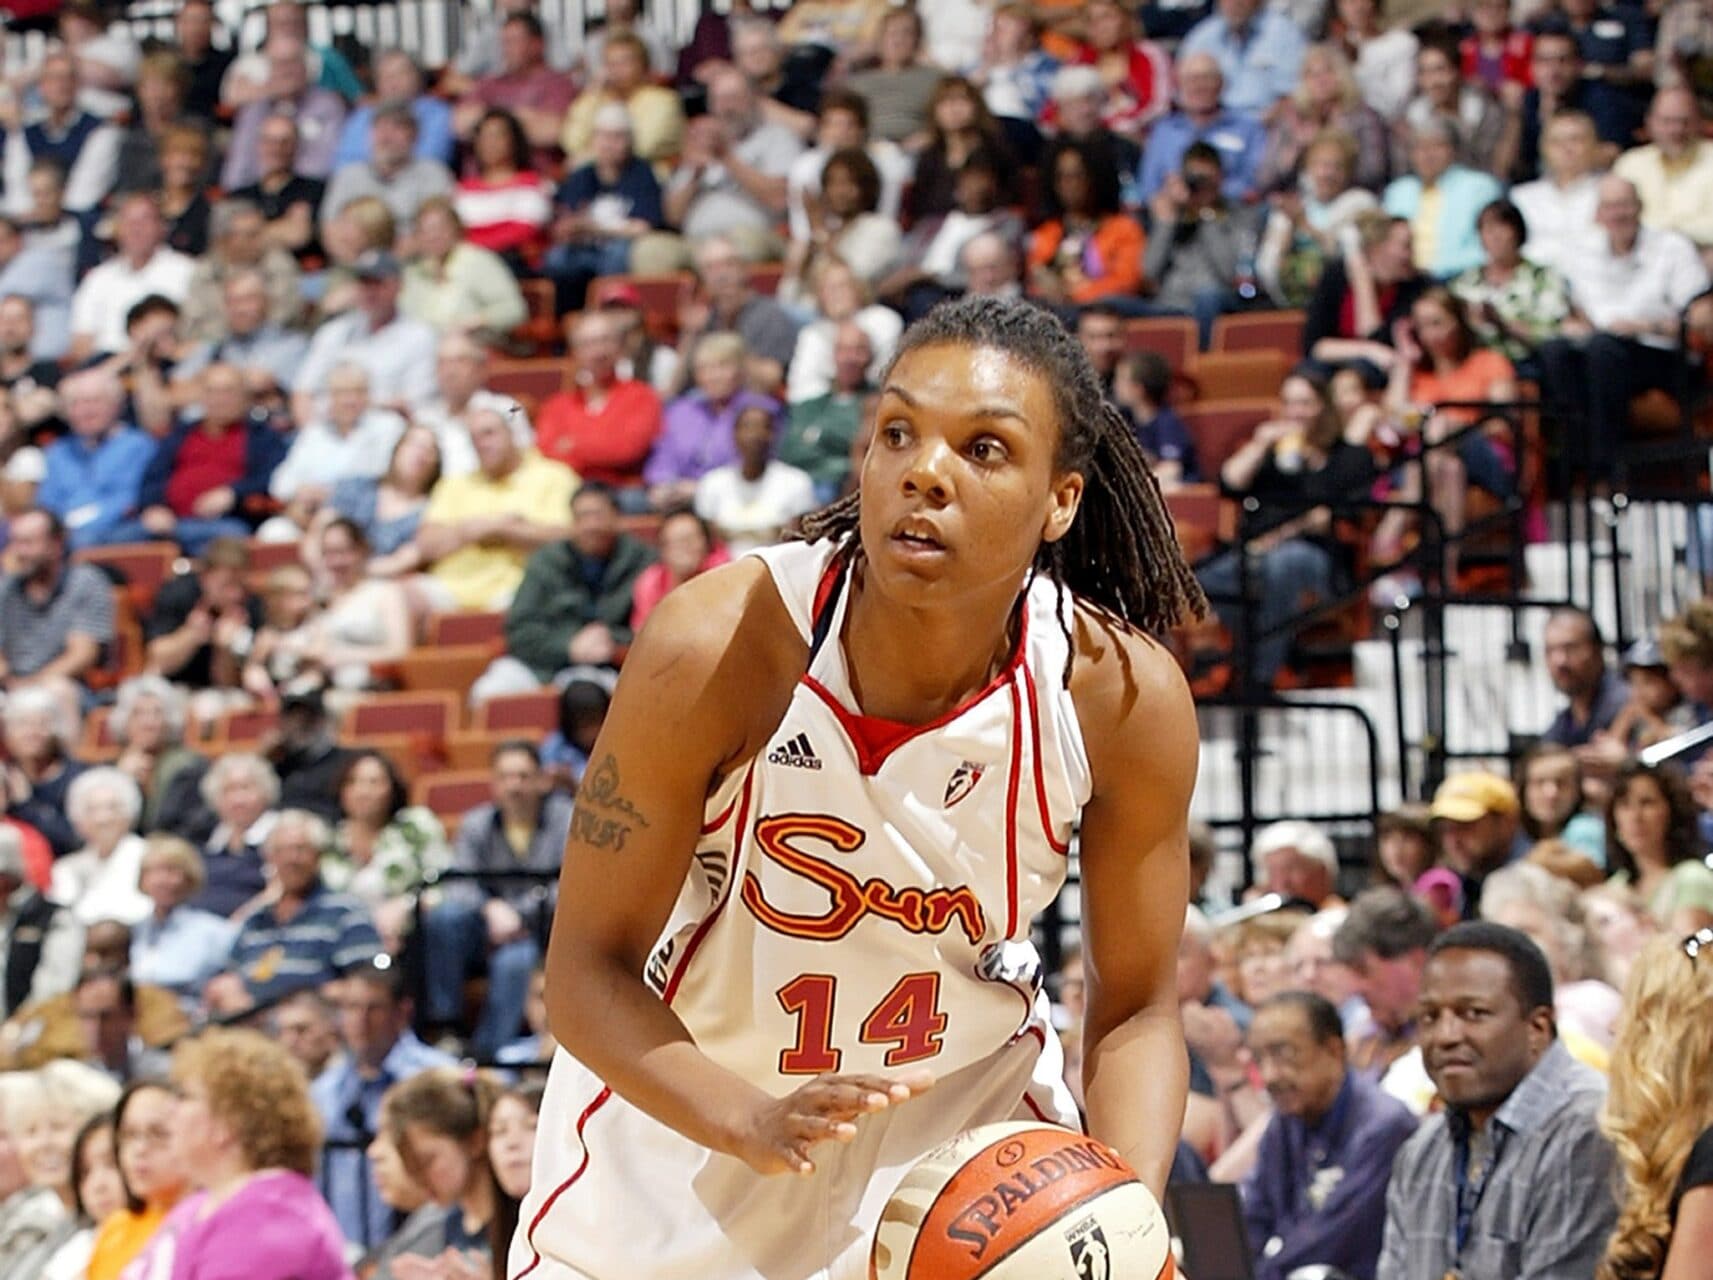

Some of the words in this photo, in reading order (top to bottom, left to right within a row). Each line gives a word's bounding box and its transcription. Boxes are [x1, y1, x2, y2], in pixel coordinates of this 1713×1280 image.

[768, 752, 822, 770] adidas
[741, 814, 986, 946] Sun
[777, 972, 948, 1075] 14
[946, 1141, 1126, 1261] SPALDING
